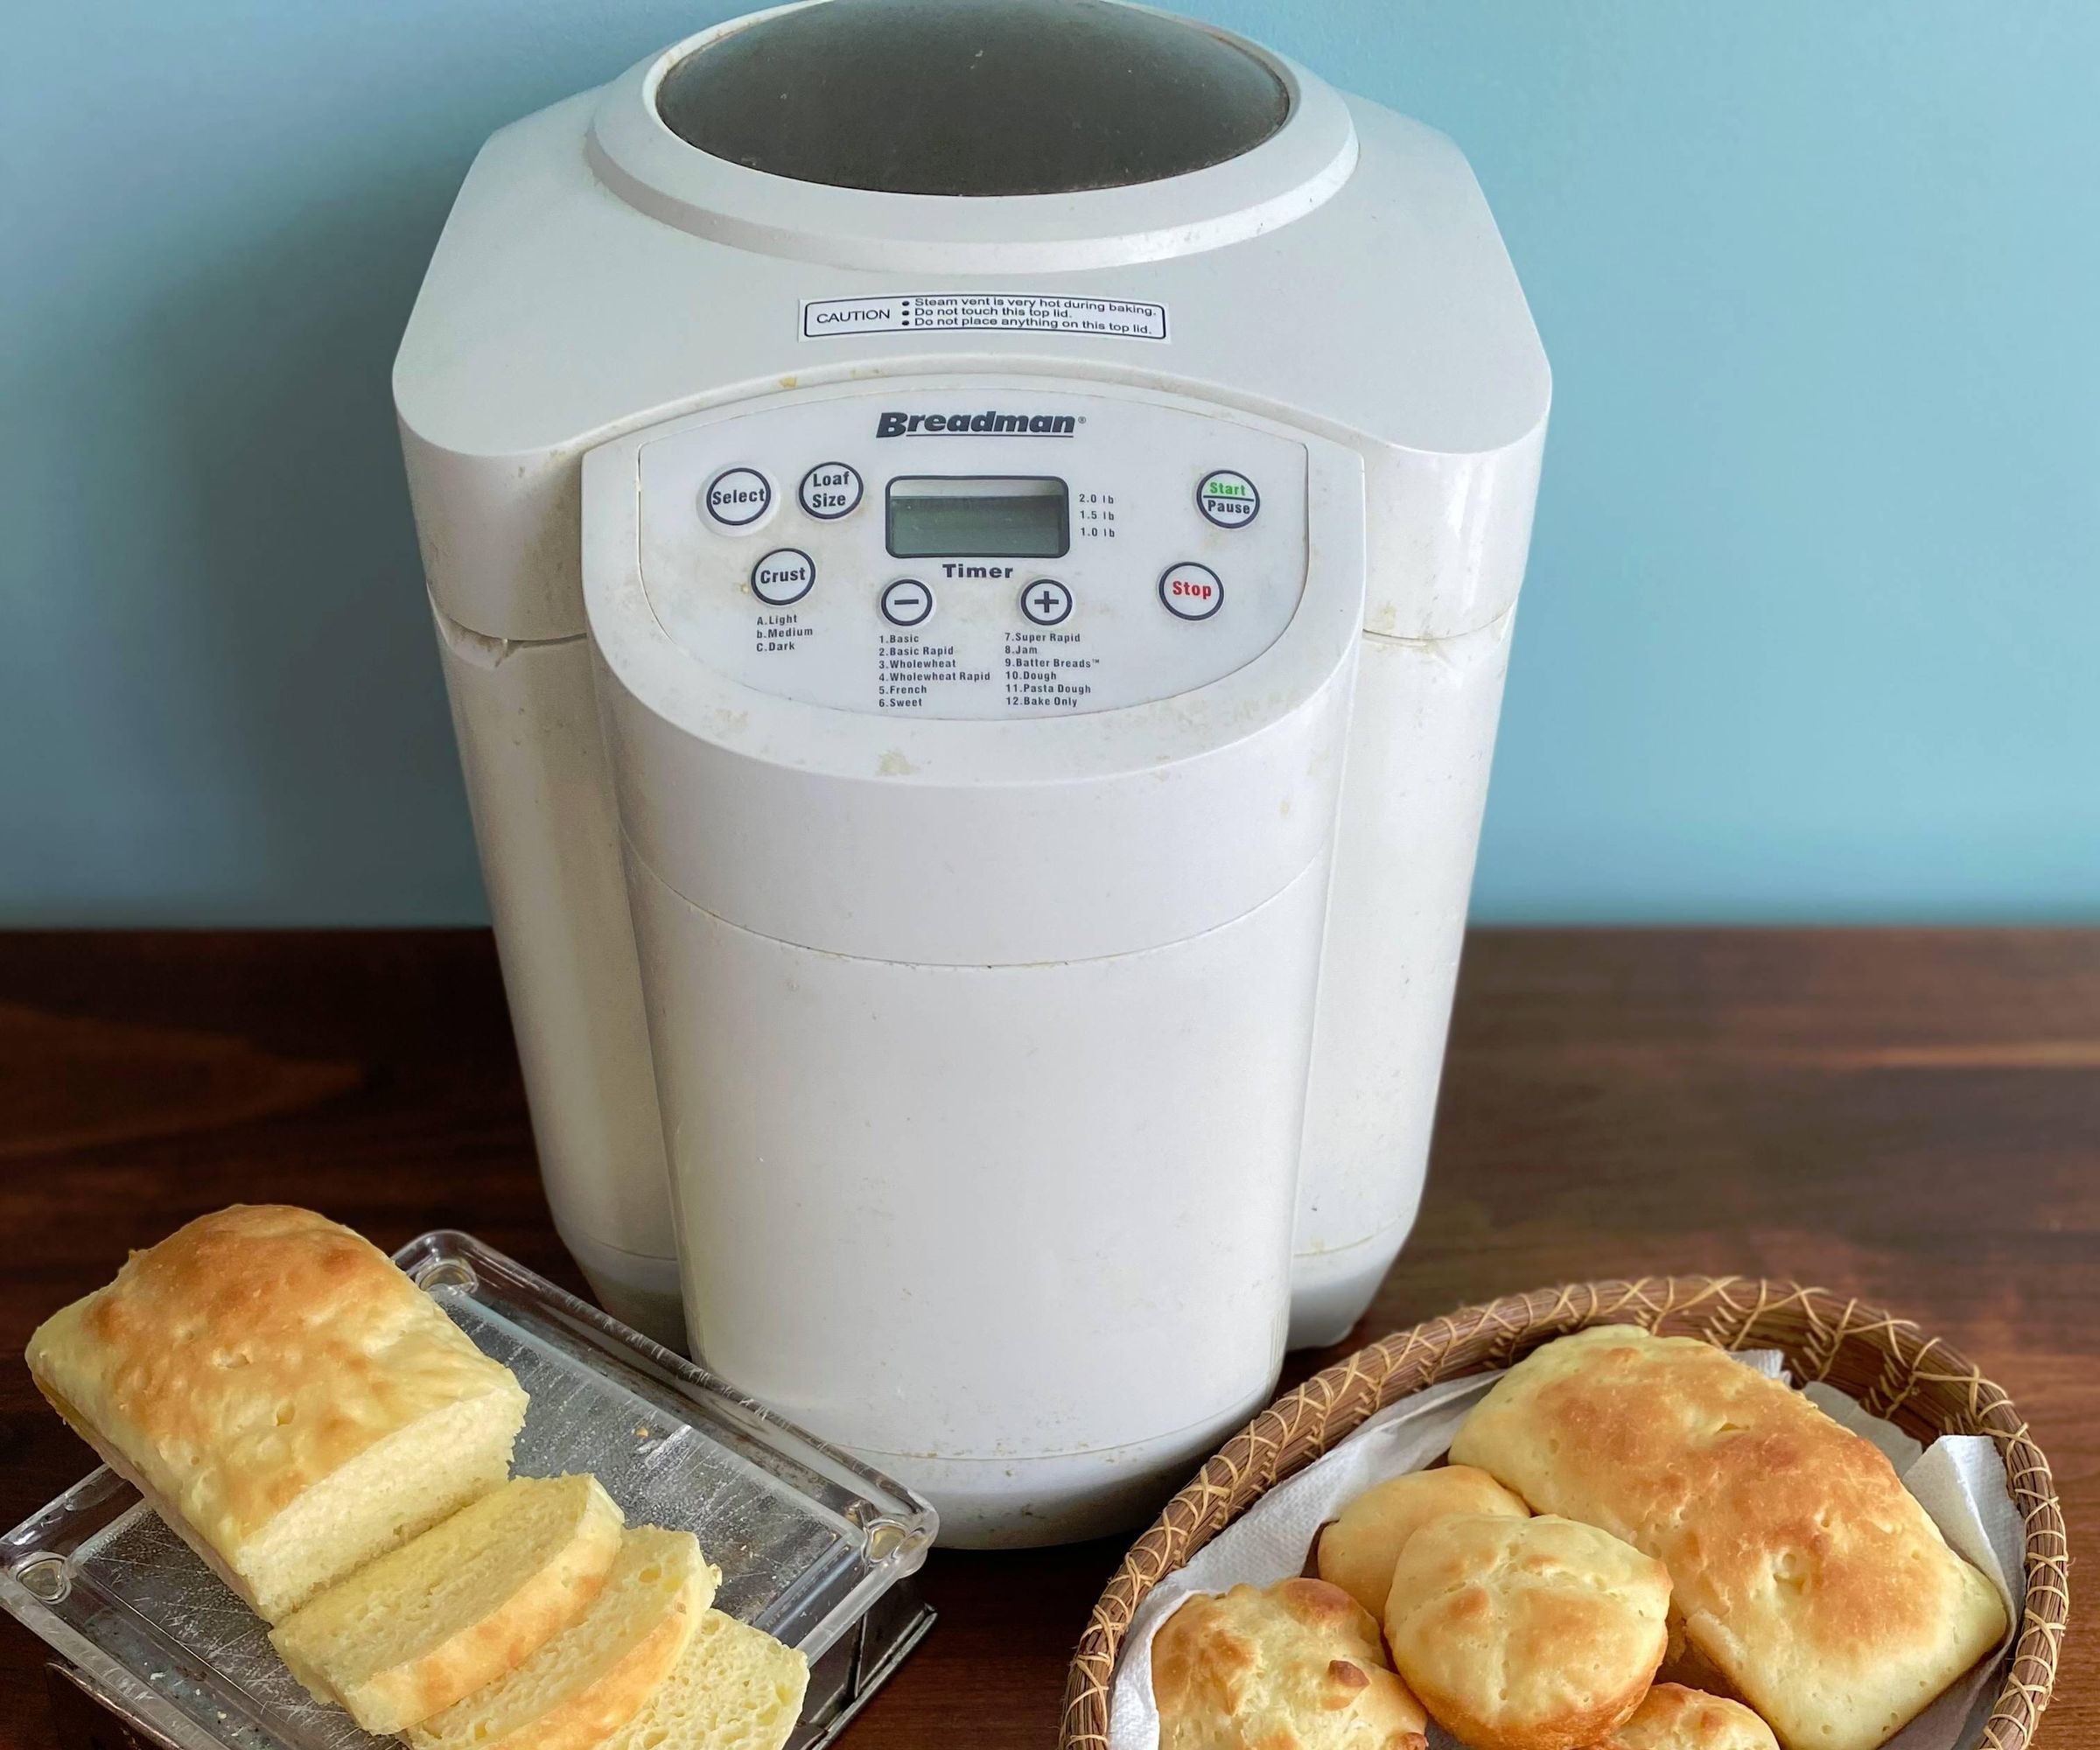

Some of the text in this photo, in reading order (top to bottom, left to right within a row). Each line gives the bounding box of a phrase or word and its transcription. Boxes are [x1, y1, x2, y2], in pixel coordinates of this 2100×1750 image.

[914, 298, 957, 306] Steam
[994, 298, 1004, 306] is
[1007, 298, 1036, 308] very
[1040, 299, 1060, 308] hot
[1064, 300, 1105, 312] during
[1110, 303, 1157, 317] baking.
[937, 307, 958, 316] not
[962, 307, 998, 316] touch
[1002, 307, 1025, 316] this
[1030, 308, 1050, 318] top
[1054, 309, 1072, 318] lid.
[816, 309, 890, 324] CAUTION
[937, 317, 958, 326] not
[962, 317, 998, 327] place
[1001, 317, 1059, 329] anything
[1082, 320, 1105, 330] this
[1110, 322, 1130, 335] top
[1133, 324, 1152, 334] lid.
[812, 471, 850, 487] Loaf
[1209, 481, 1246, 496] Start
[712, 488, 766, 505] Select
[812, 493, 846, 508] Size
[1079, 493, 1115, 505] 2.0 lb
[1208, 500, 1250, 514] Pause
[1080, 509, 1115, 522] 1.5 lb
[1080, 527, 1116, 538] 1.0 lb
[760, 567, 806, 584] Crust
[942, 564, 1014, 578] Timer
[1172, 580, 1212, 600] Stop
[756, 614, 797, 626] A.Light
[878, 634, 920, 644] 1.Basic
[1004, 632, 1081, 644] 7.Super Rapid
[756, 641, 795, 652] C.Dark
[878, 646, 954, 657] 2.Basic Rapid
[1004, 645, 1038, 654] 8.Jam
[878, 659, 956, 669] 3.Wholewheat
[1004, 658, 1050, 668] 9.Batter
[878, 671, 990, 682] 4.Wholewheat Rapid
[1005, 670, 1057, 682] 10.Dough
[878, 684, 928, 695] 5.French
[1005, 683, 1091, 695] 11.Pasta Dough
[878, 698, 922, 708] 6.Sweet
[1005, 696, 1078, 708] 12.Bake Only
